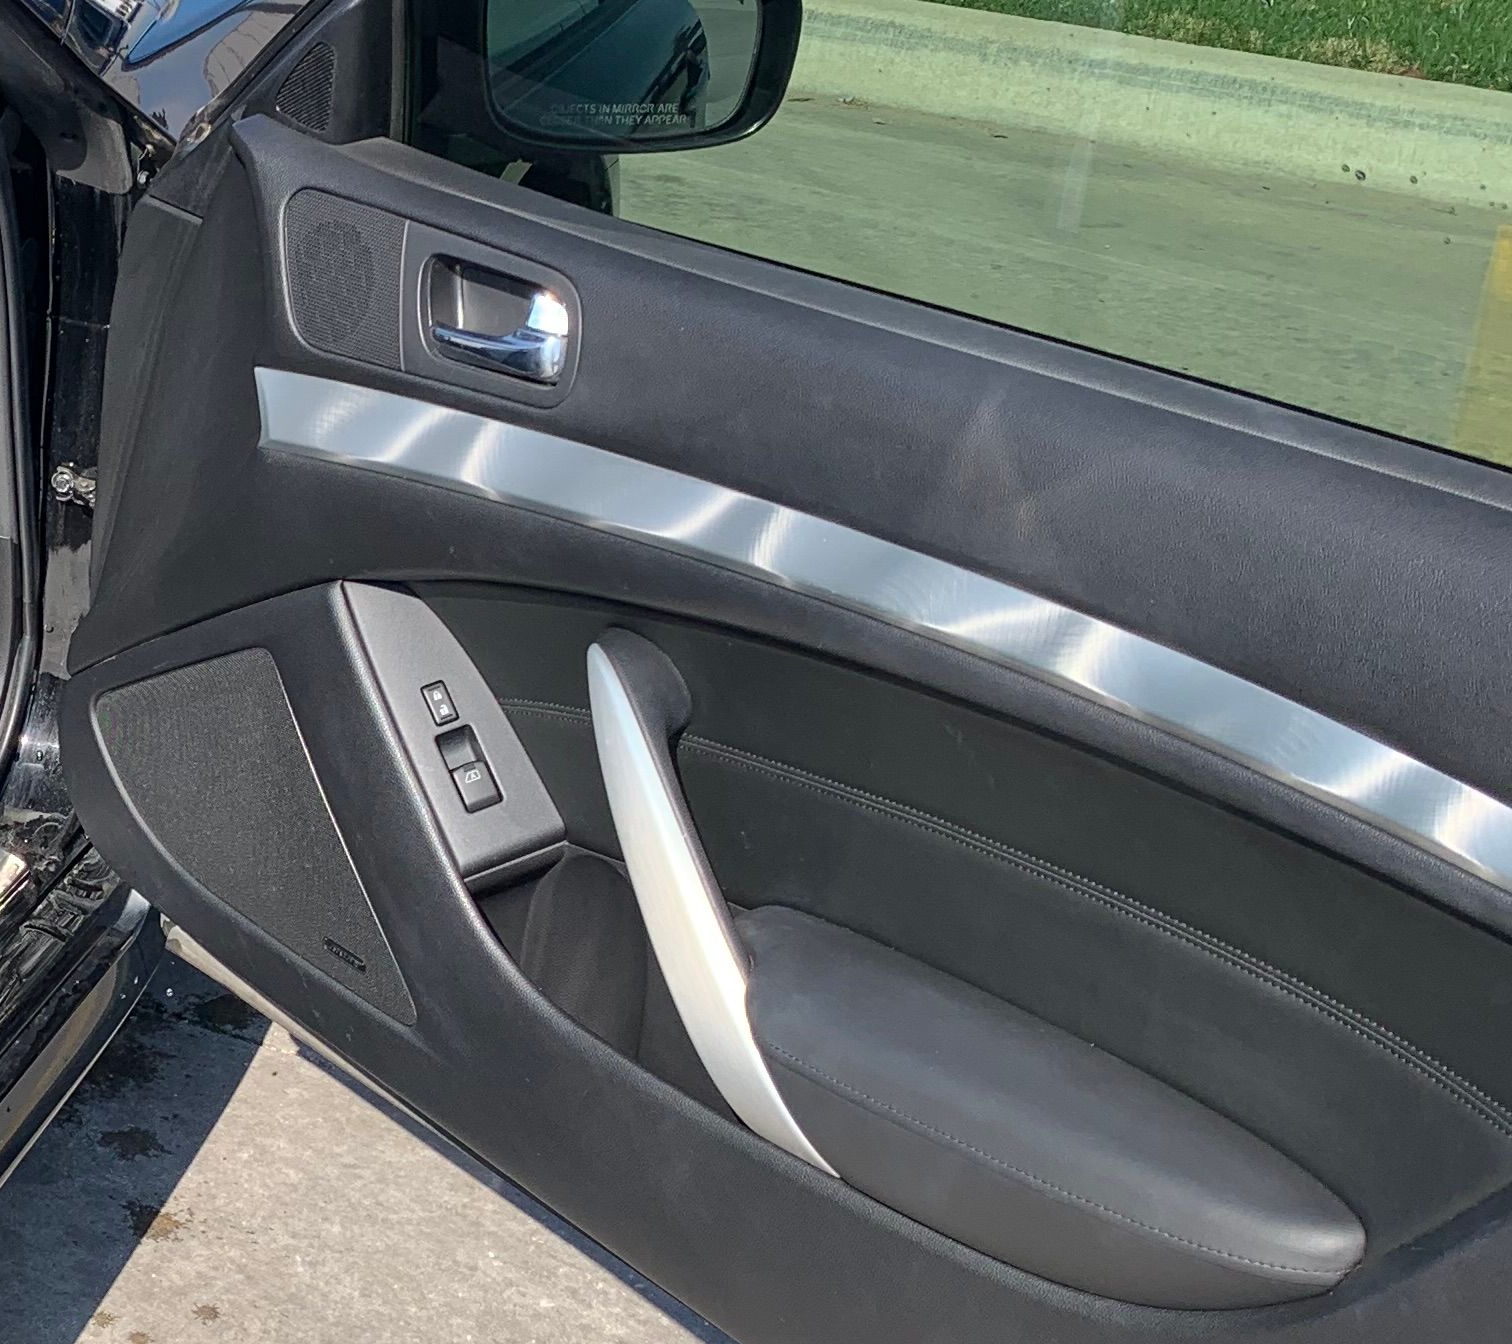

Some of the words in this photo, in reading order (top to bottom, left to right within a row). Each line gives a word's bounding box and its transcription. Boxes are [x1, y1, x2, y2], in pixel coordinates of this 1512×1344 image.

[598, 104, 610, 114] IN
[612, 103, 654, 114] MIRROR
[657, 103, 679, 114] ARE
[615, 114, 642, 126] THEY
[643, 114, 688, 125] APPEAR
